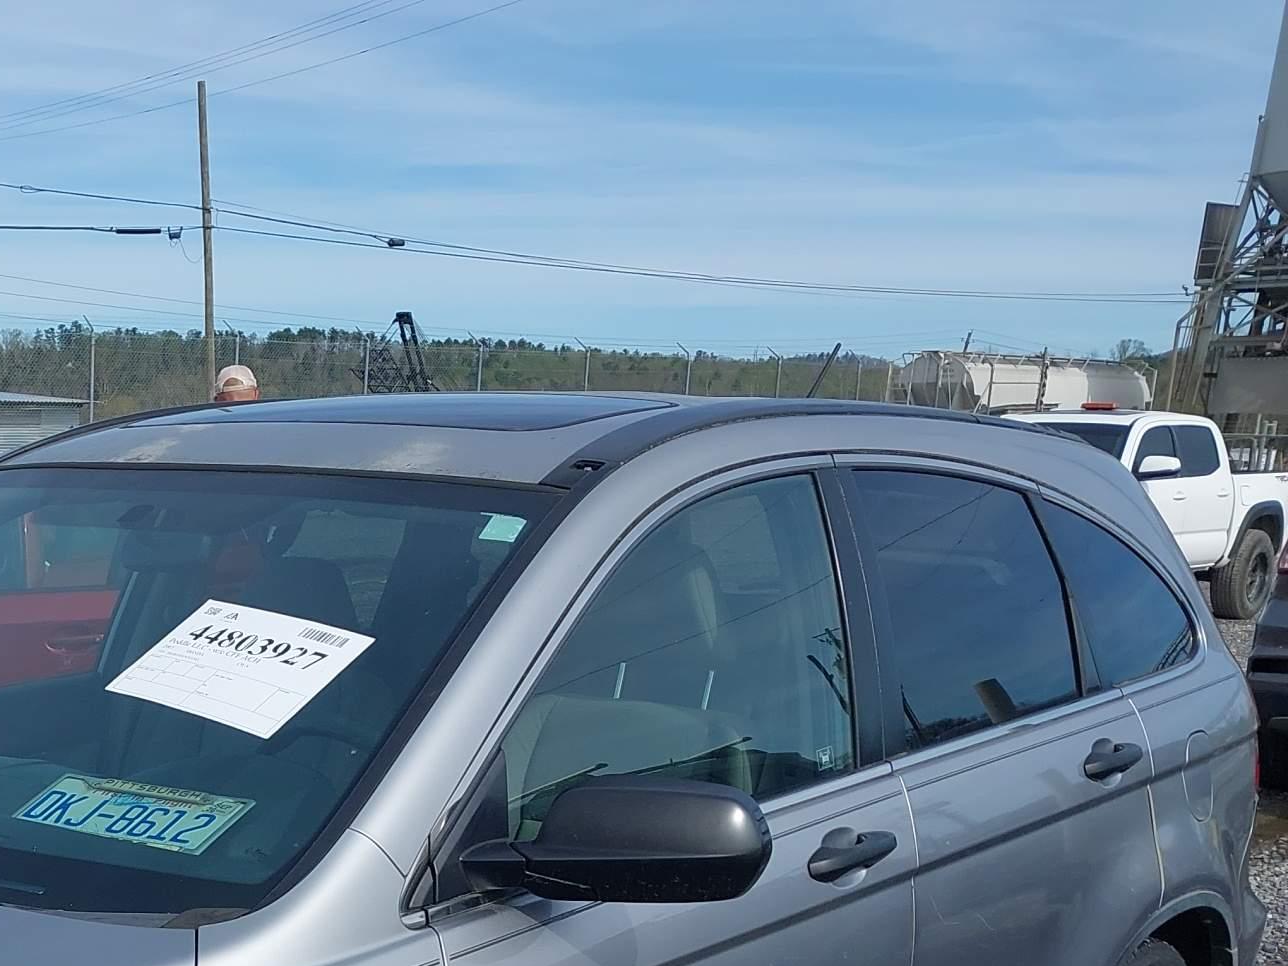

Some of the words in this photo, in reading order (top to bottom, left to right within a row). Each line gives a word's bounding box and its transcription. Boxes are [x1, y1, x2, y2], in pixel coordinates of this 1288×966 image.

[189, 624, 329, 670] 44803927
[103, 779, 202, 799] PITTSBURGH
[23, 789, 217, 844] DKJ-8612
